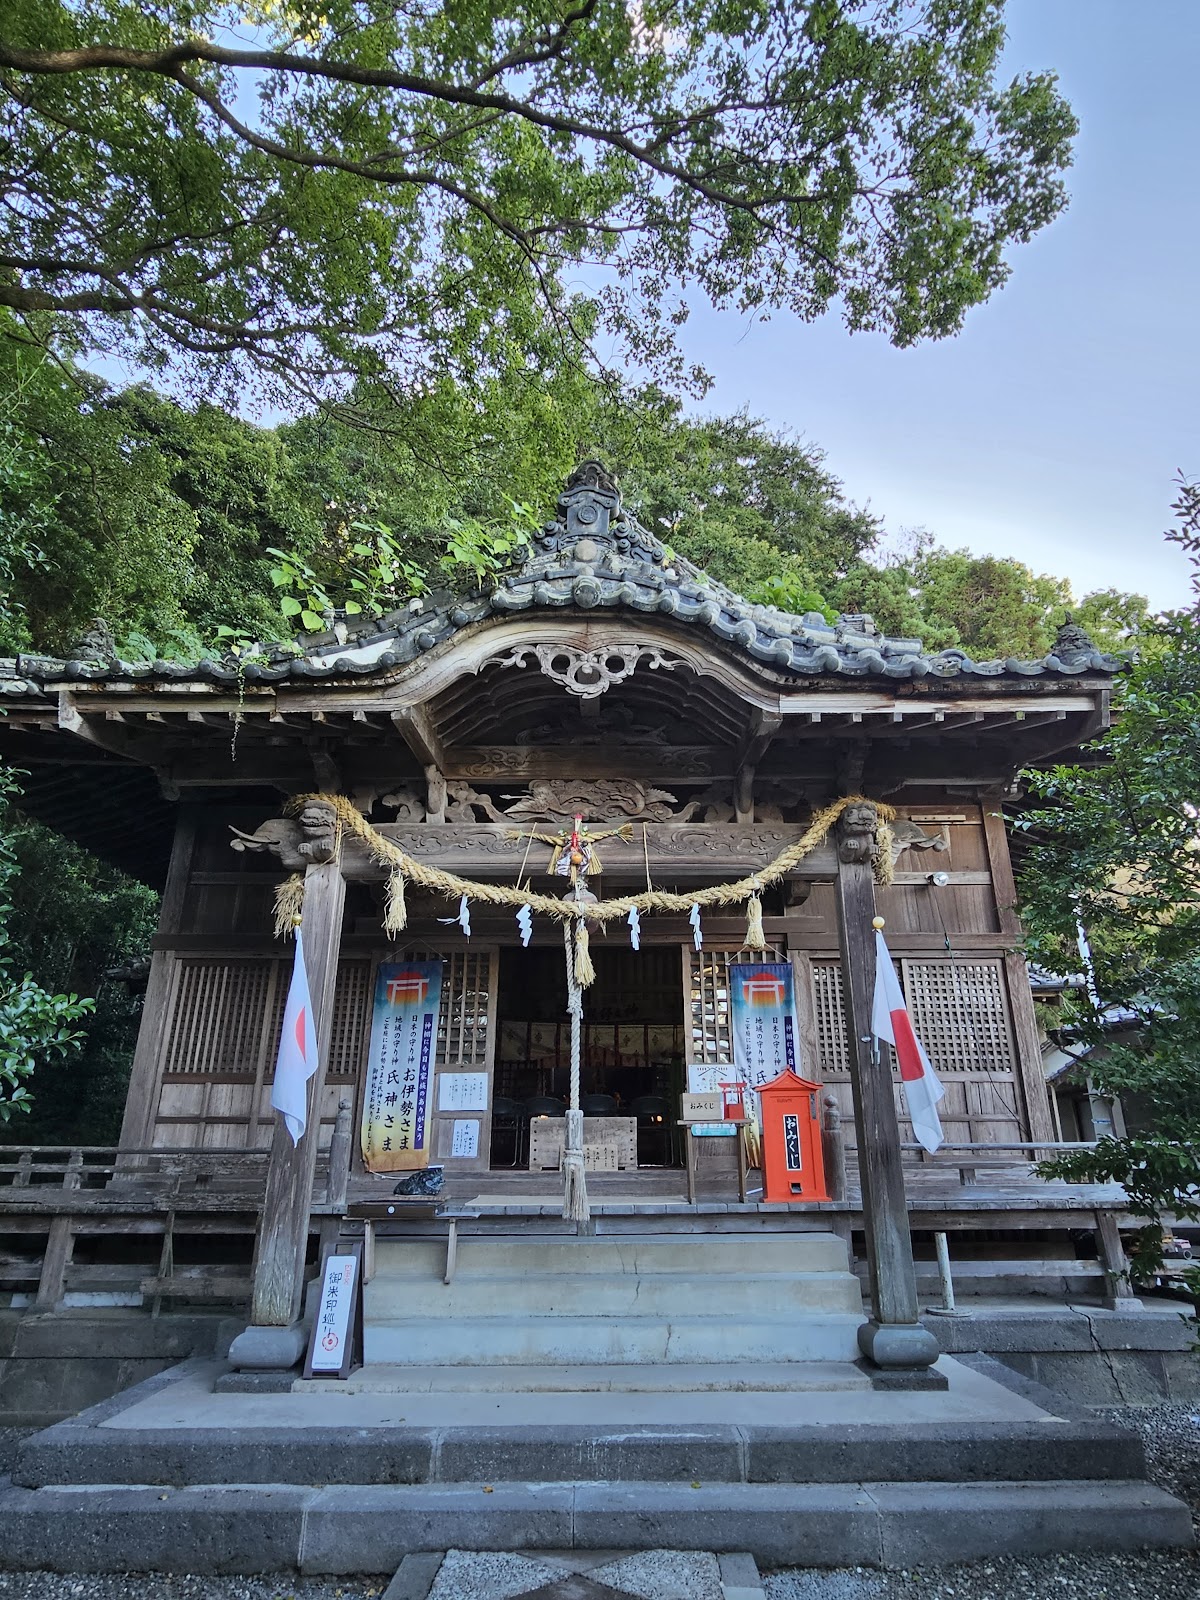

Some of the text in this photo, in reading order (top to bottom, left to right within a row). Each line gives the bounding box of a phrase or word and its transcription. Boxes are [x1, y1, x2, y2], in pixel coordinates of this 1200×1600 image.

[755, 1016, 765, 1066] 地域の守り神
[772, 1016, 781, 1066] 日本の守り神
[786, 1024, 794, 1069] 神棚に今日
[382, 1016, 403, 1151] 地域の守り神 氏神さま
[399, 1015, 418, 1150] 日本の守り神 お伊勢さま
[690, 1102, 715, 1110] おみくじ
[786, 1116, 799, 1168] おみくじ
[322, 1271, 343, 1339] 御米印巡り
